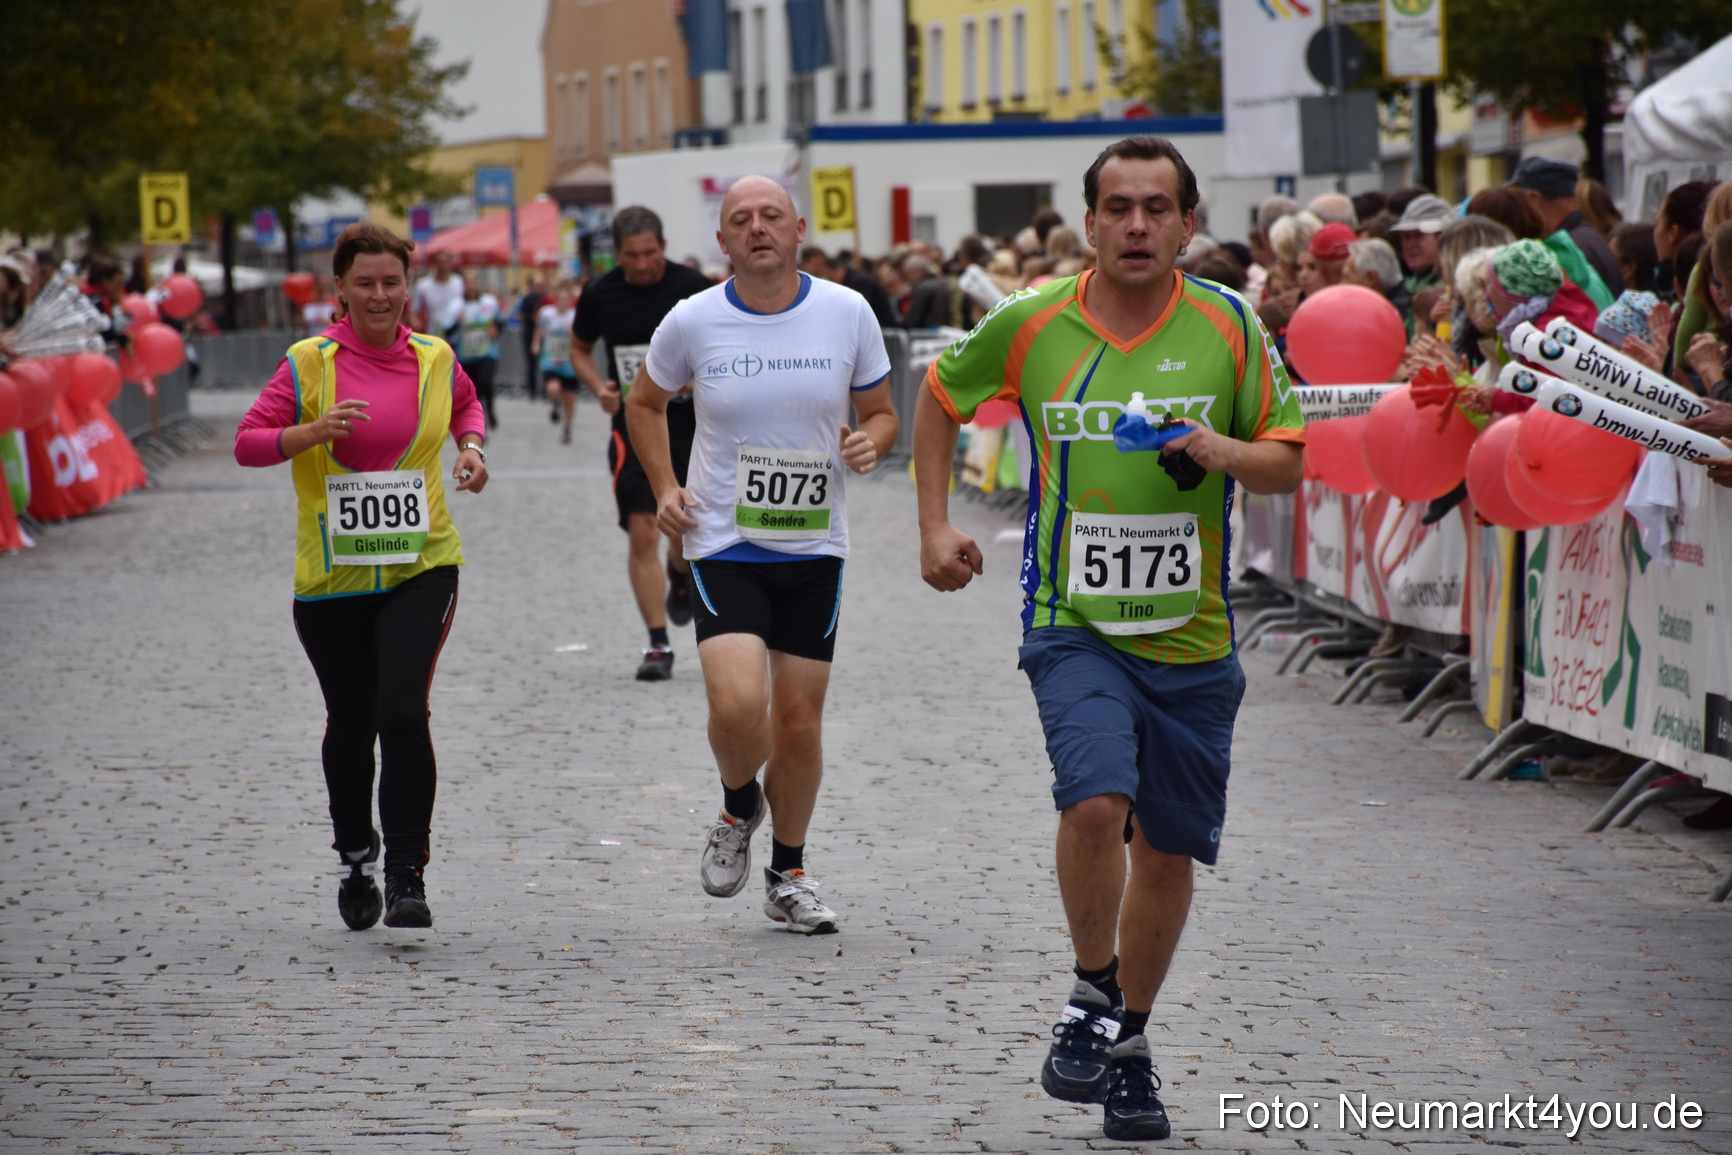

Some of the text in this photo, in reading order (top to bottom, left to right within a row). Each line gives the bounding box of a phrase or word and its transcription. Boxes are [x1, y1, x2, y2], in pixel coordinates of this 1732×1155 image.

[823, 187, 847, 219] D
[154, 196, 178, 229] D
[708, 358, 832, 376] FeG NEUMARKT
[1574, 352, 1632, 388] BMW
[740, 454, 823, 469] PARTL Neumarkt
[328, 480, 411, 492] PARTL Neumarkt
[746, 469, 828, 506] 5073
[340, 493, 421, 530] 5098
[760, 512, 805, 527] Sandra
[1075, 524, 1180, 538] PARTL Neumarkt
[355, 537, 409, 553] Gislinde
[1084, 543, 1191, 588] 5173
[1118, 601, 1154, 618] Tino
